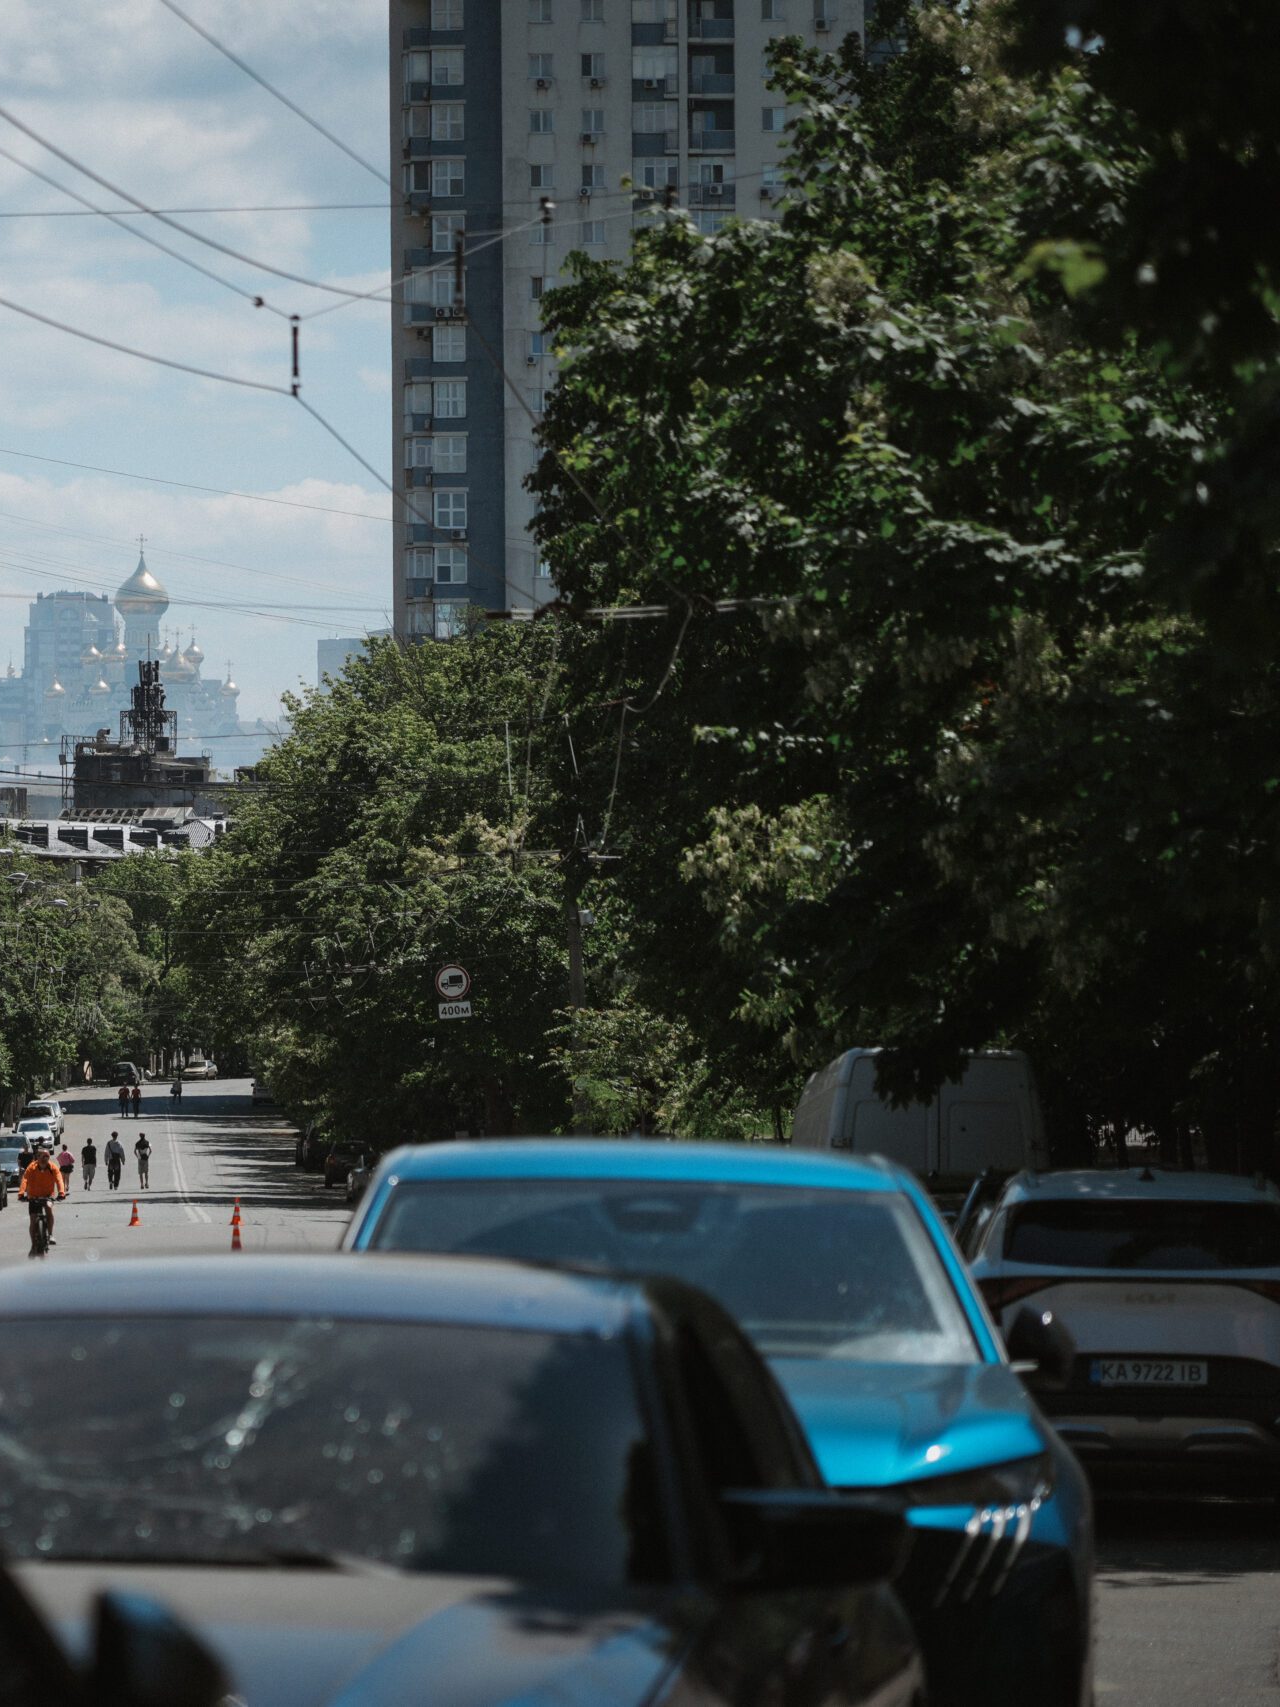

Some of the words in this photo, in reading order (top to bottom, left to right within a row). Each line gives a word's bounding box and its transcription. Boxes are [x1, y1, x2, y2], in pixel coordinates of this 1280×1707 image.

[1101, 1363, 1128, 1380] KA
[1131, 1363, 1175, 1382] 9722
[1180, 1364, 1202, 1382] IB
